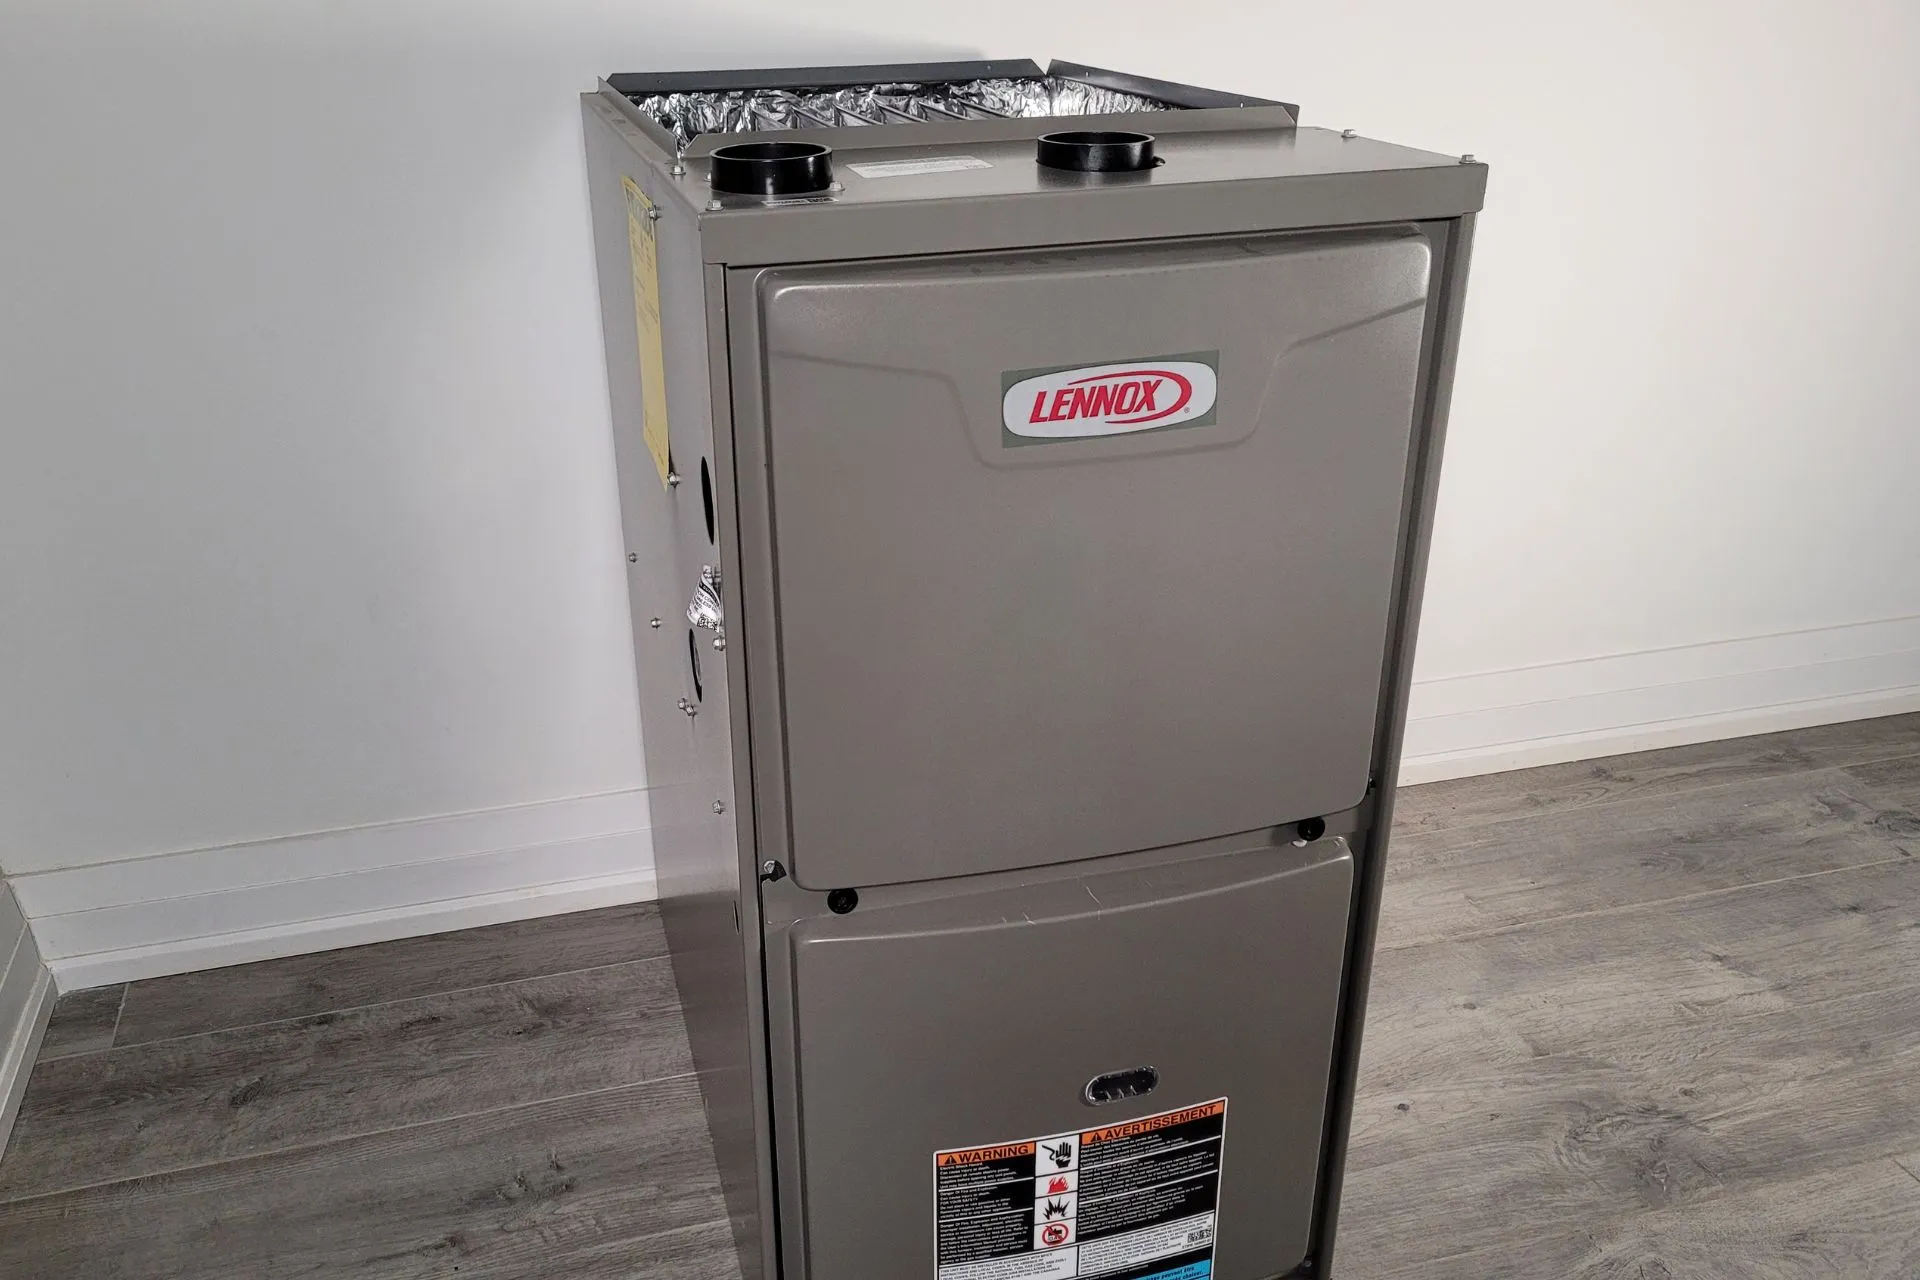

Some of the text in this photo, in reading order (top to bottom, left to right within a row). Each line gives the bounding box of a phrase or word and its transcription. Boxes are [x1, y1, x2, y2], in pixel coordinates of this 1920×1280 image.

[1029, 379, 1163, 424] LENNOX
[1105, 1105, 1217, 1140] AVERTISSEMENT
[959, 1146, 1028, 1162] WARNING
